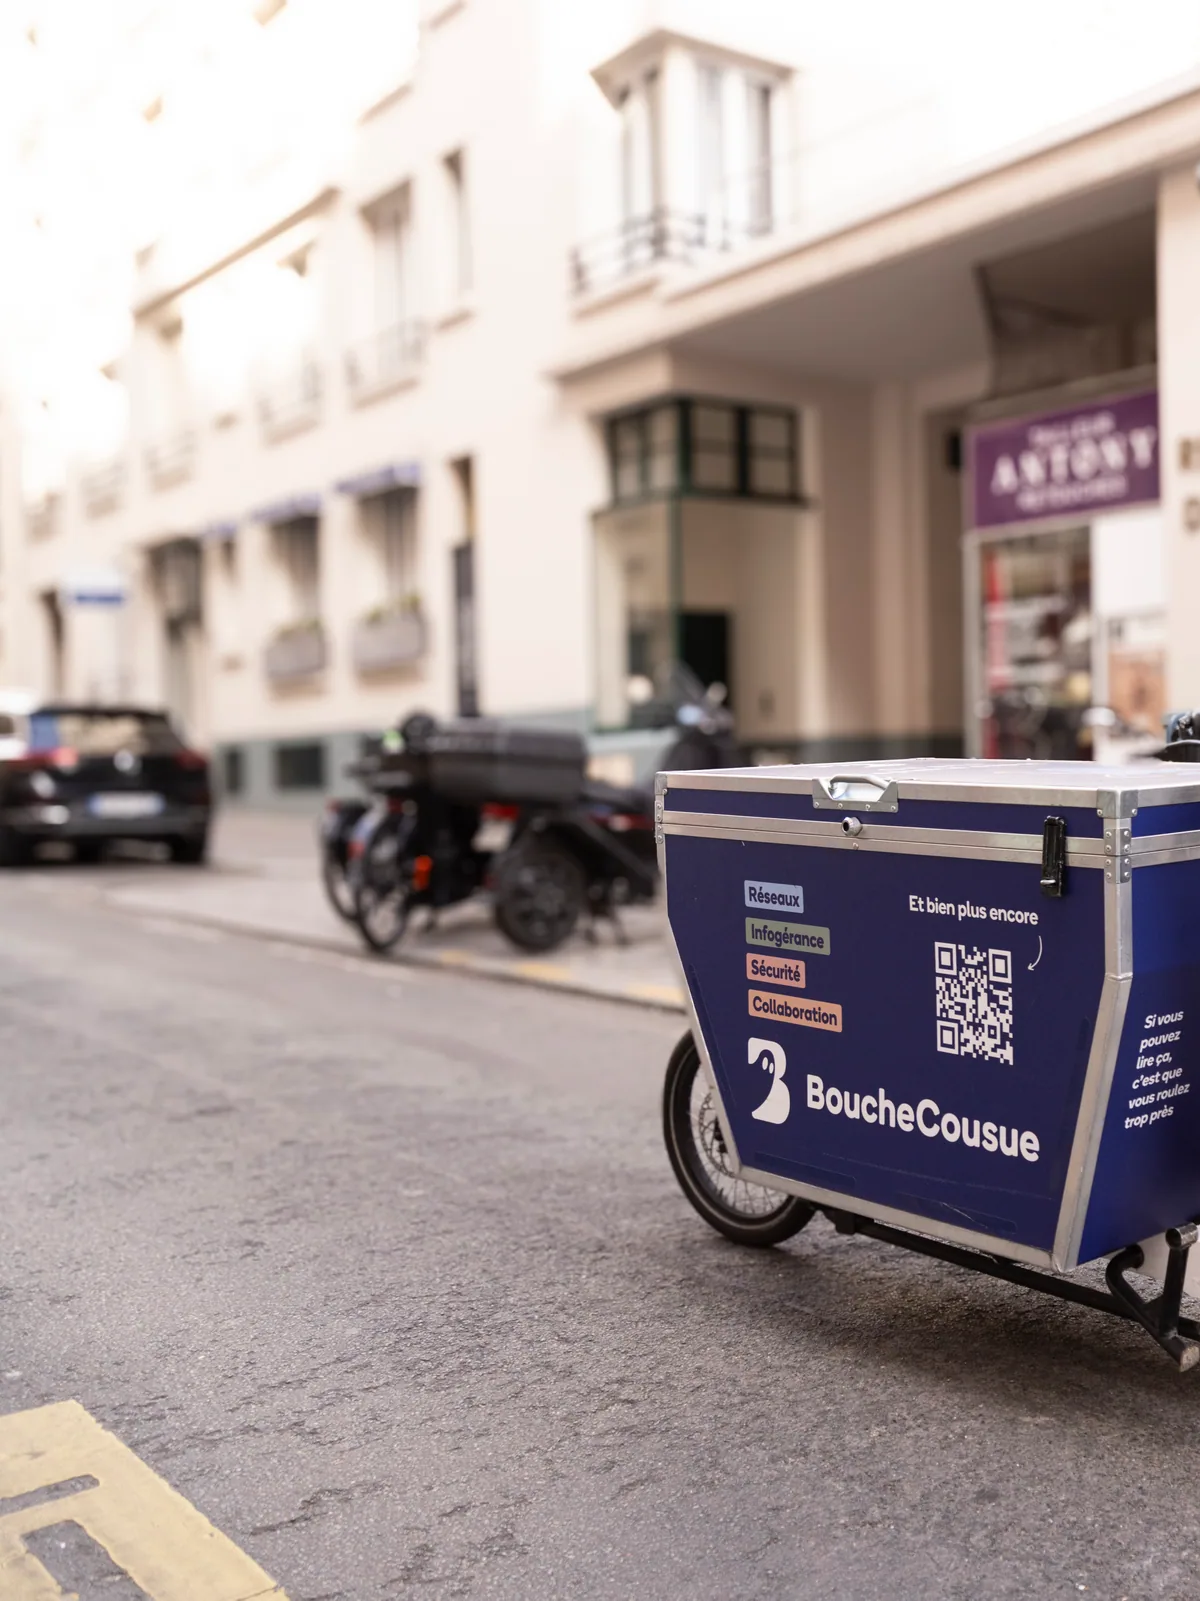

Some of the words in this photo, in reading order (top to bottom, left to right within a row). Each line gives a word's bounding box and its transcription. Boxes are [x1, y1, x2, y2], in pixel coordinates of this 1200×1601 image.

[990, 425, 1157, 496] ANTONY
[748, 886, 800, 907] Réseaux
[908, 894, 925, 912] Et
[926, 896, 956, 916] bien
[957, 900, 987, 921] plus
[989, 907, 1039, 926] encore
[751, 923, 825, 949] Infogérance
[751, 959, 801, 982] Sécurité
[752, 996, 838, 1026] Collaboration
[1143, 1013, 1157, 1029] Si
[1157, 1011, 1184, 1026] vous
[1139, 1030, 1182, 1053] pouvez
[1135, 1055, 1155, 1070] lire
[1155, 1051, 1173, 1067] ça,
[1131, 1071, 1161, 1090] c'est
[1161, 1067, 1183, 1084] que
[1128, 1093, 1156, 1109] vous
[1156, 1083, 1191, 1101] roulez
[806, 1073, 1040, 1162] BoucheCousue
[1124, 1114, 1149, 1129] trop
[1148, 1104, 1174, 1125] près
